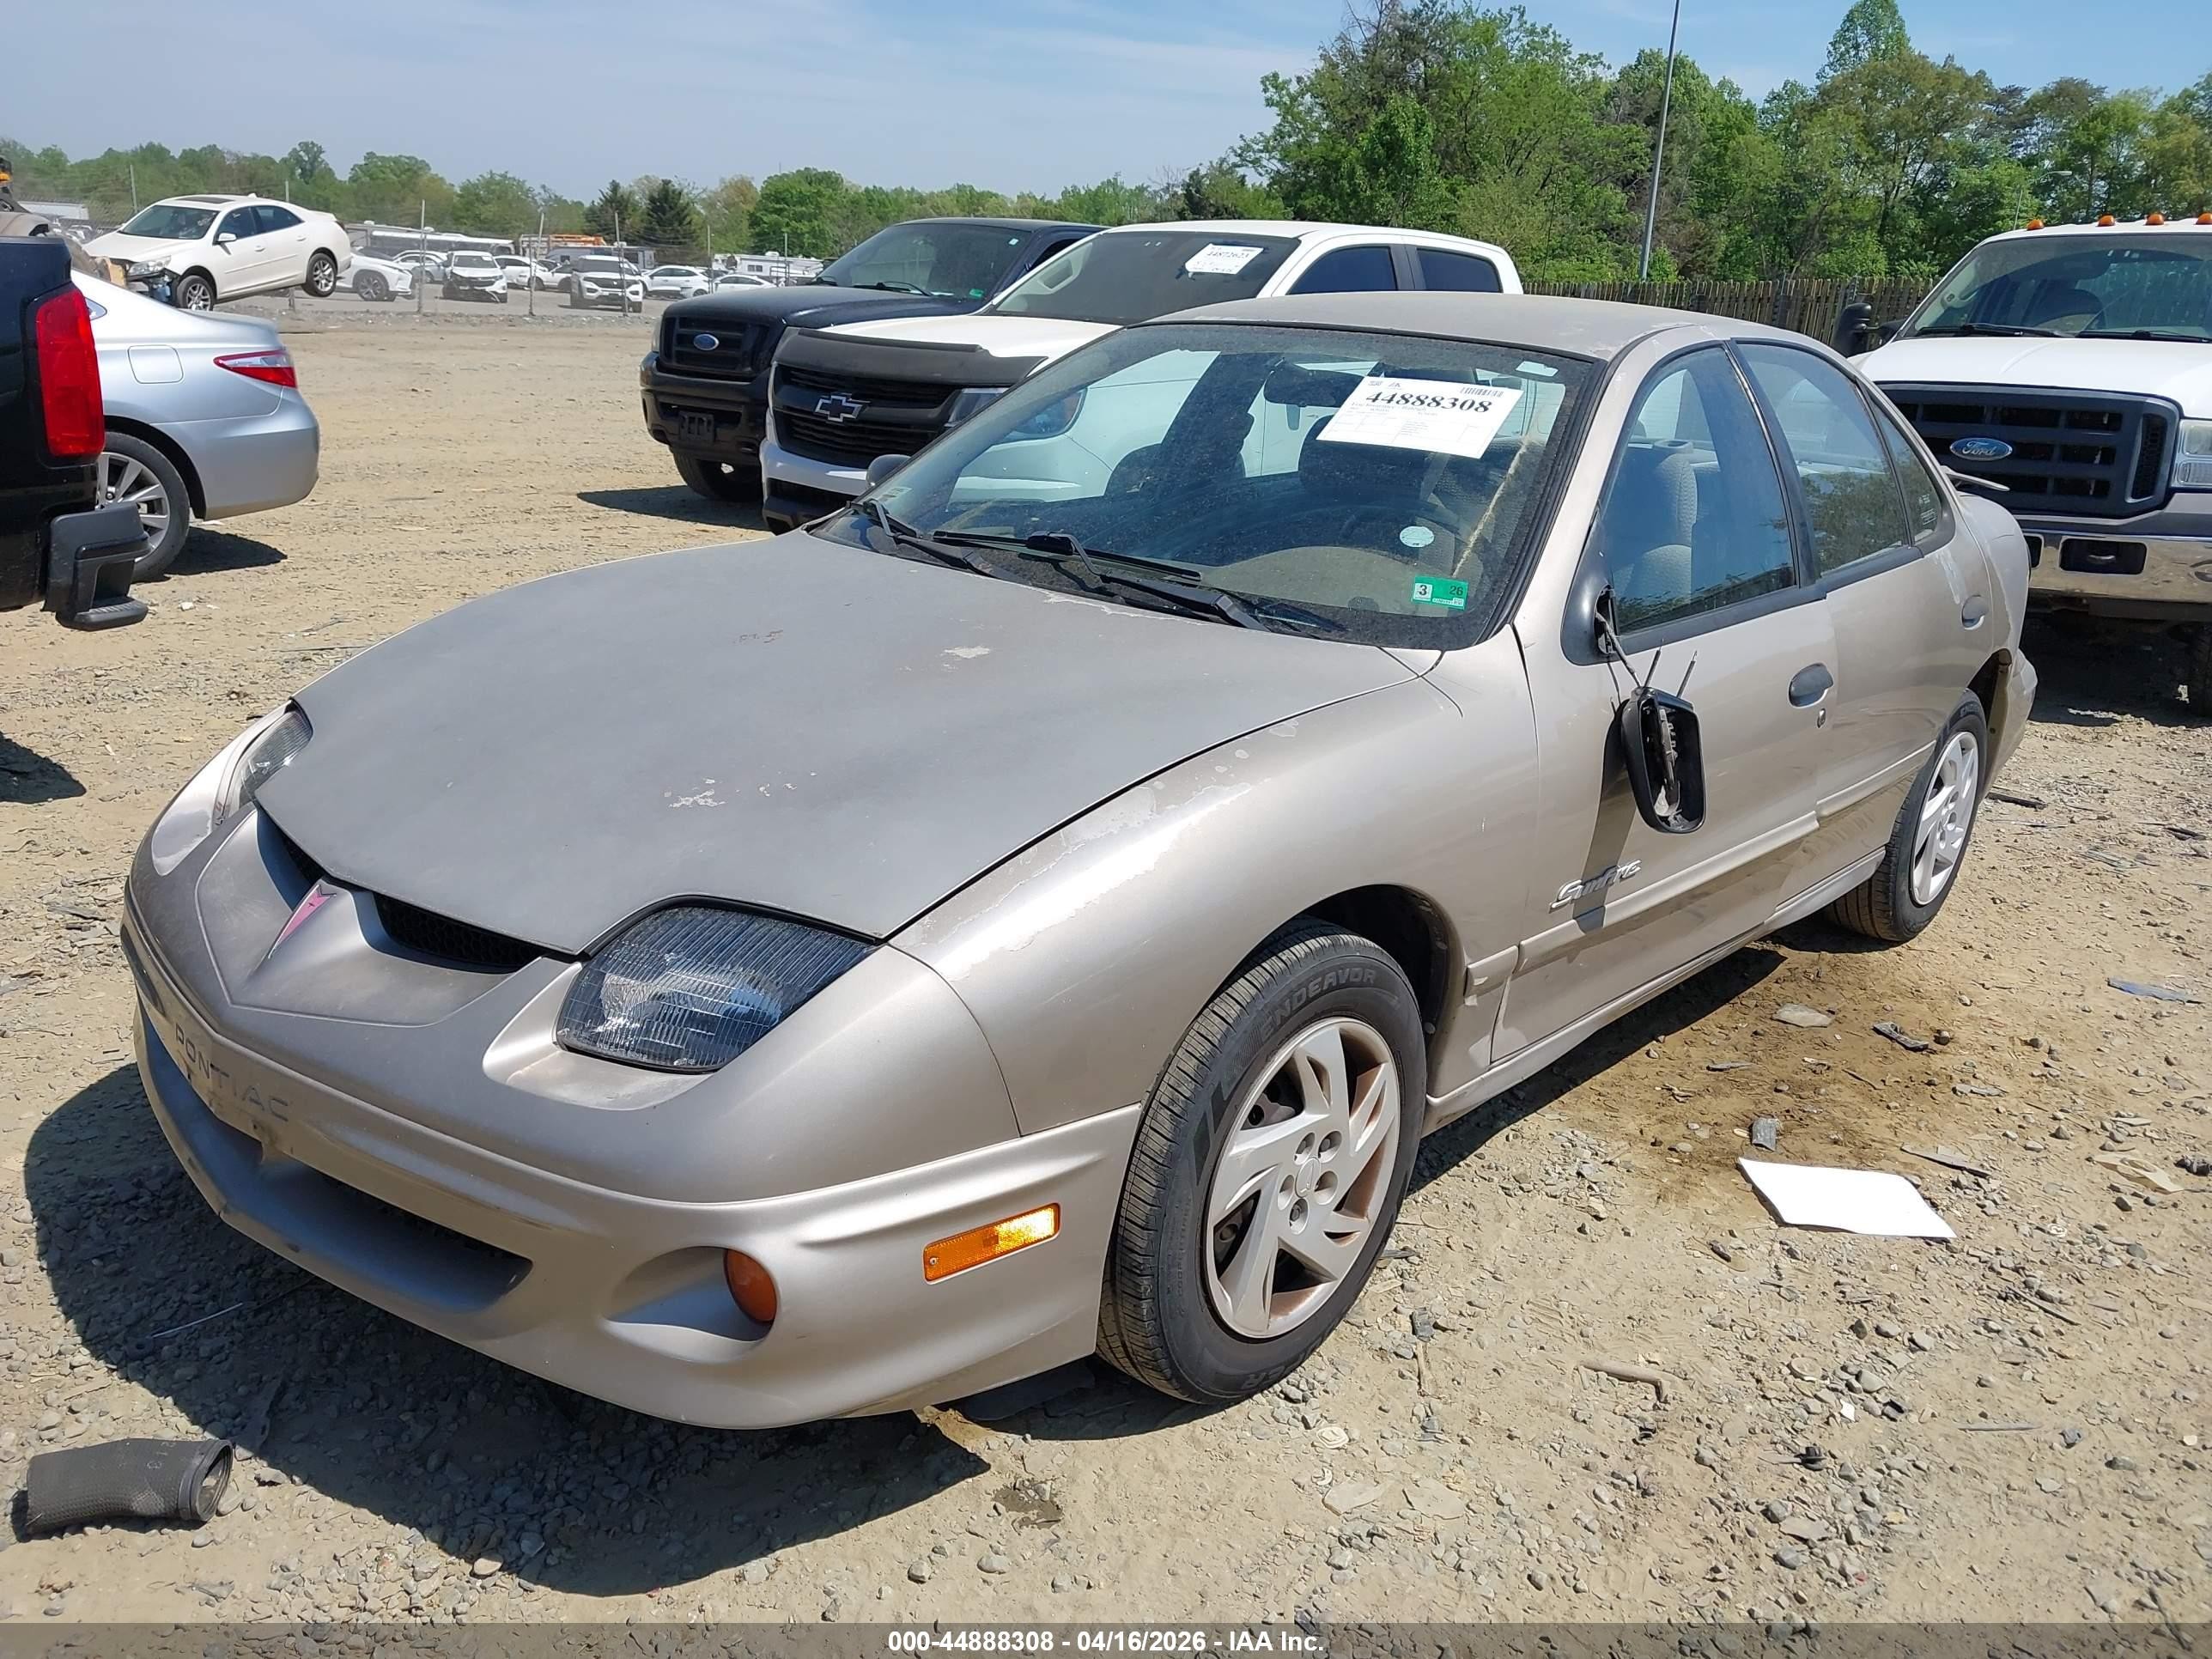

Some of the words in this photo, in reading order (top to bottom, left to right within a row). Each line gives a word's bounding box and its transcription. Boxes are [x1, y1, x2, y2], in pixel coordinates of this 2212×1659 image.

[1365, 391, 1492, 413] 44888308
[1962, 441, 1997, 456] Ford
[1419, 584, 1428, 596] 3
[1449, 585, 1464, 596] 26
[1263, 968, 1376, 1042] ENDEAVOR
[175, 1022, 289, 1122] PONTIAC
